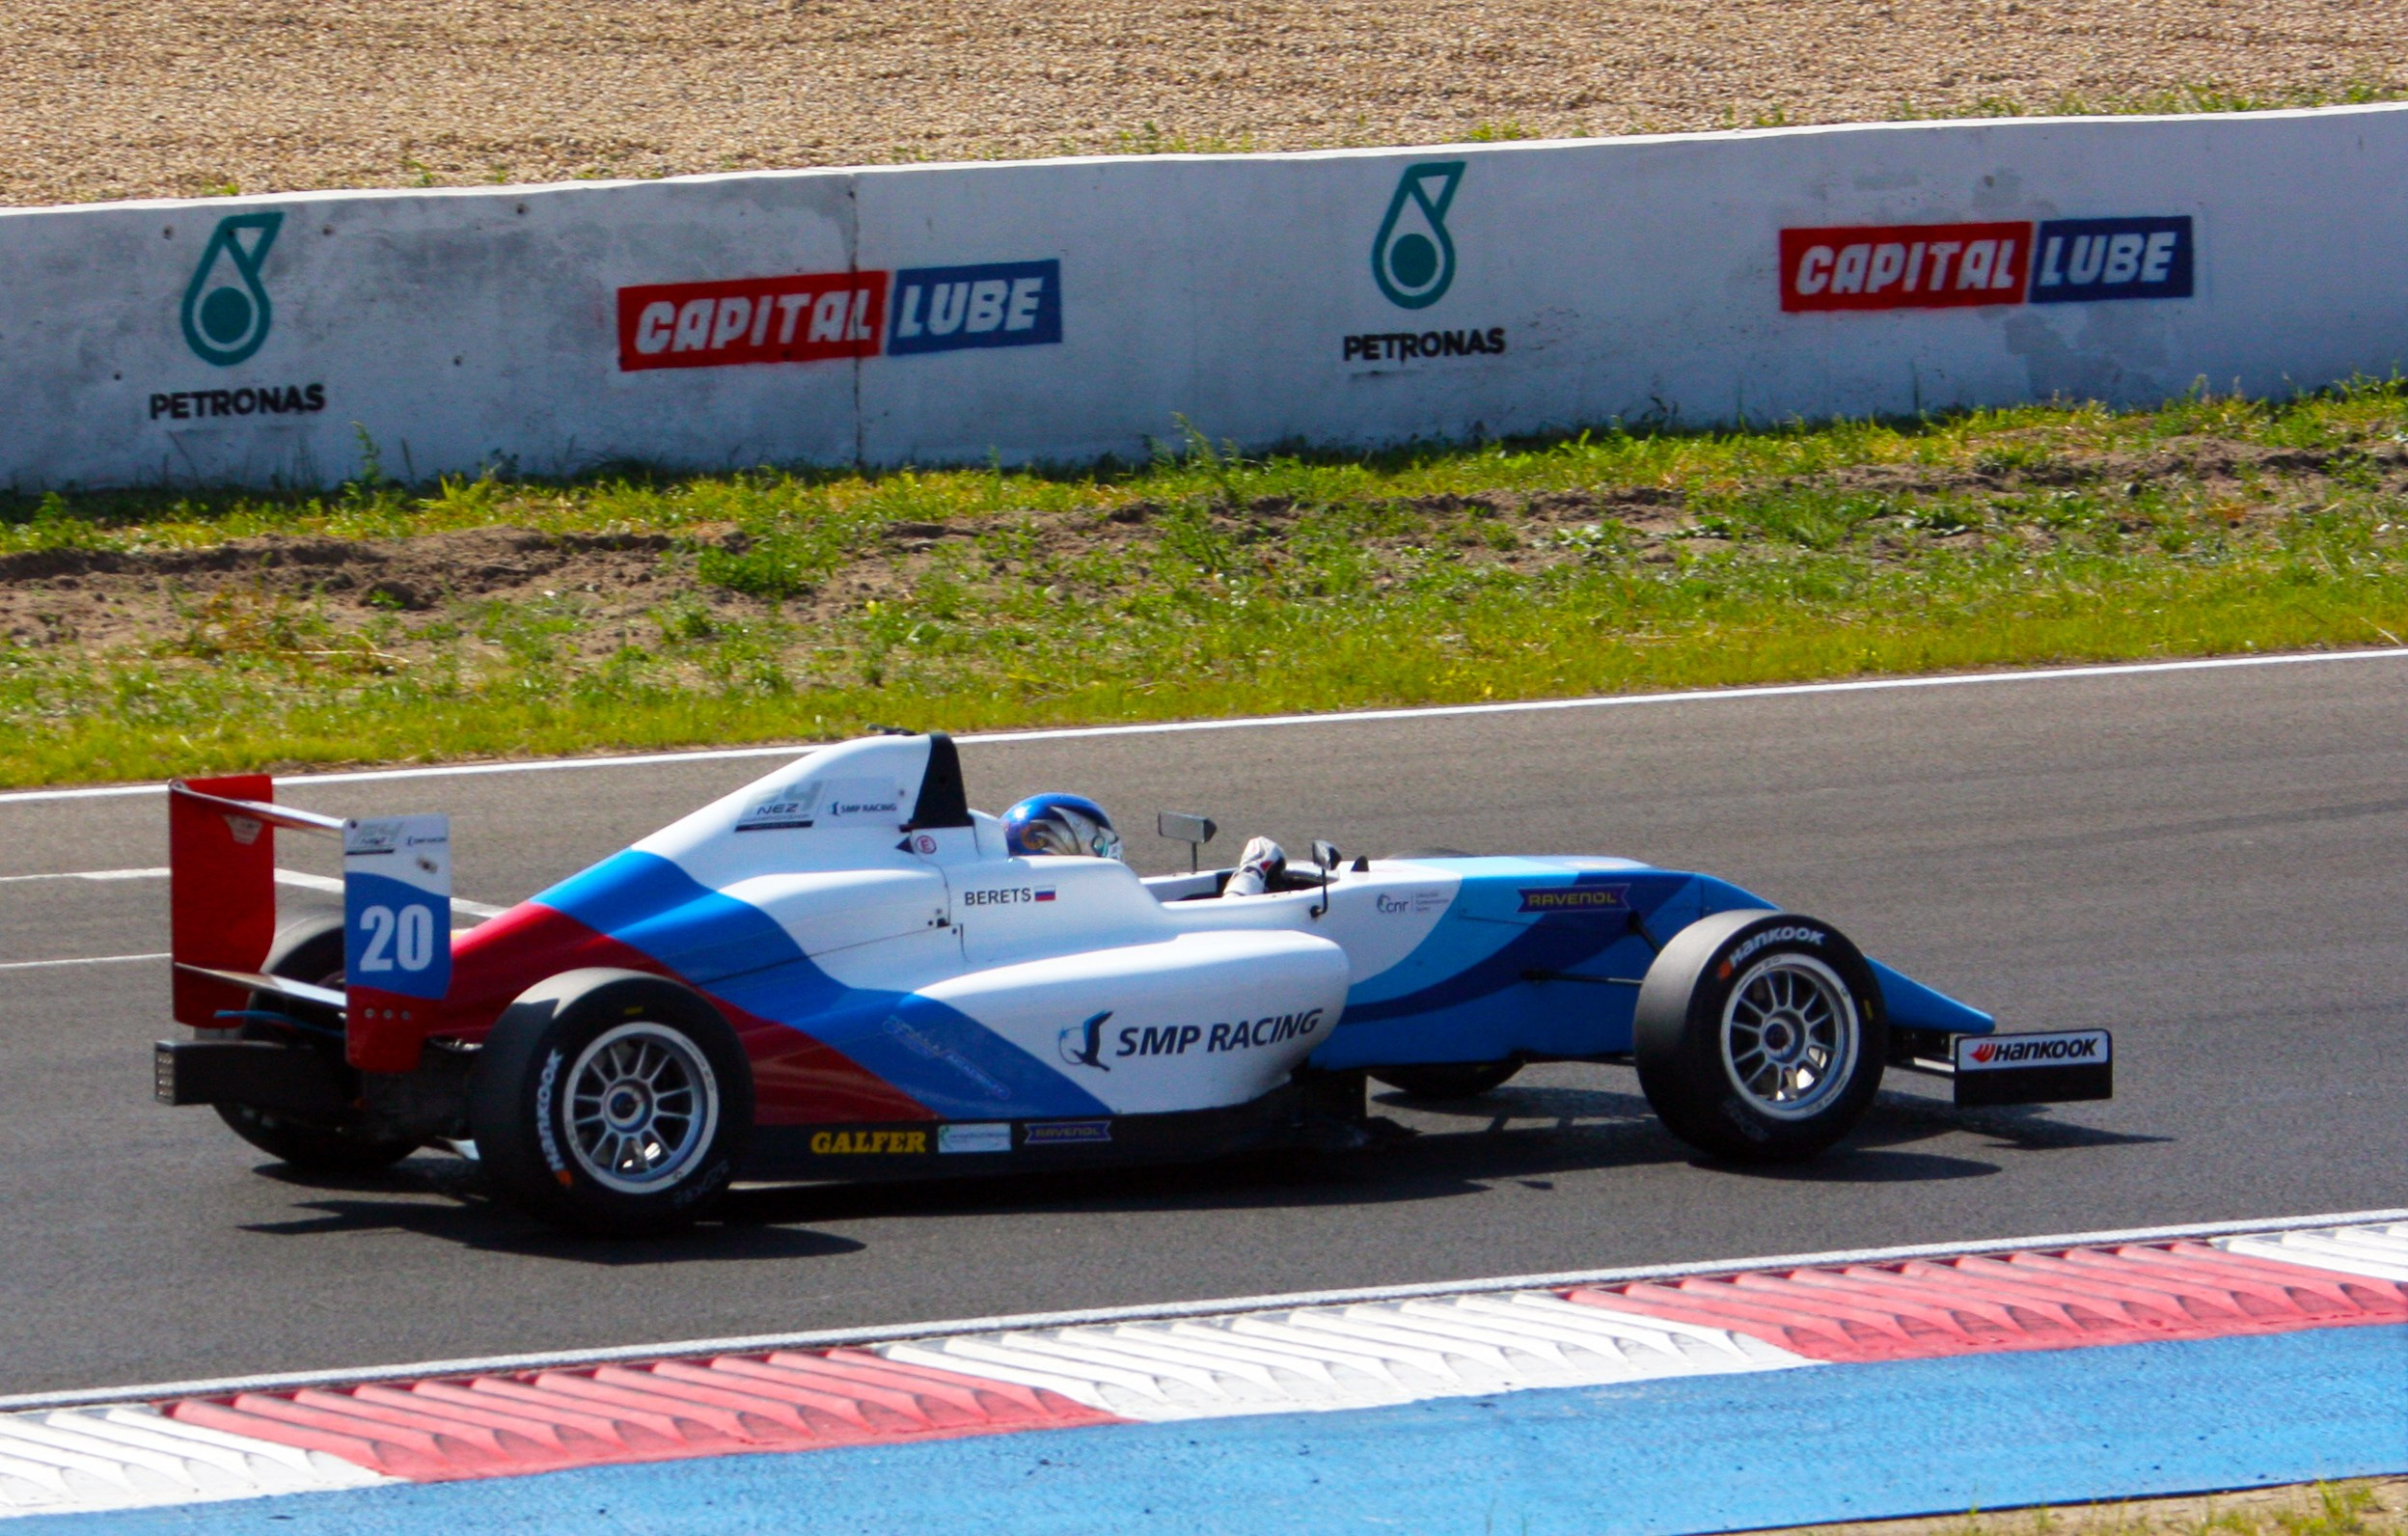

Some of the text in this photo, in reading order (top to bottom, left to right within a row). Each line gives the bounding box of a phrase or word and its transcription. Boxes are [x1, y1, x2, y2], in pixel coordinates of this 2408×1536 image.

[1795, 233, 2177, 294] CAPITAL LUBE
[634, 277, 1043, 356] CAPITAL LUBE
[1342, 326, 1506, 362] PETRONAS
[149, 382, 325, 420] PETRONAS
[756, 803, 800, 816] NEZ
[862, 803, 897, 812] RACING
[965, 888, 1031, 906] BERETS
[1528, 891, 1617, 906] RAVENOL
[359, 903, 434, 973] 20
[1115, 1008, 1324, 1056] SMP RACING
[809, 1132, 927, 1154] GALFER
